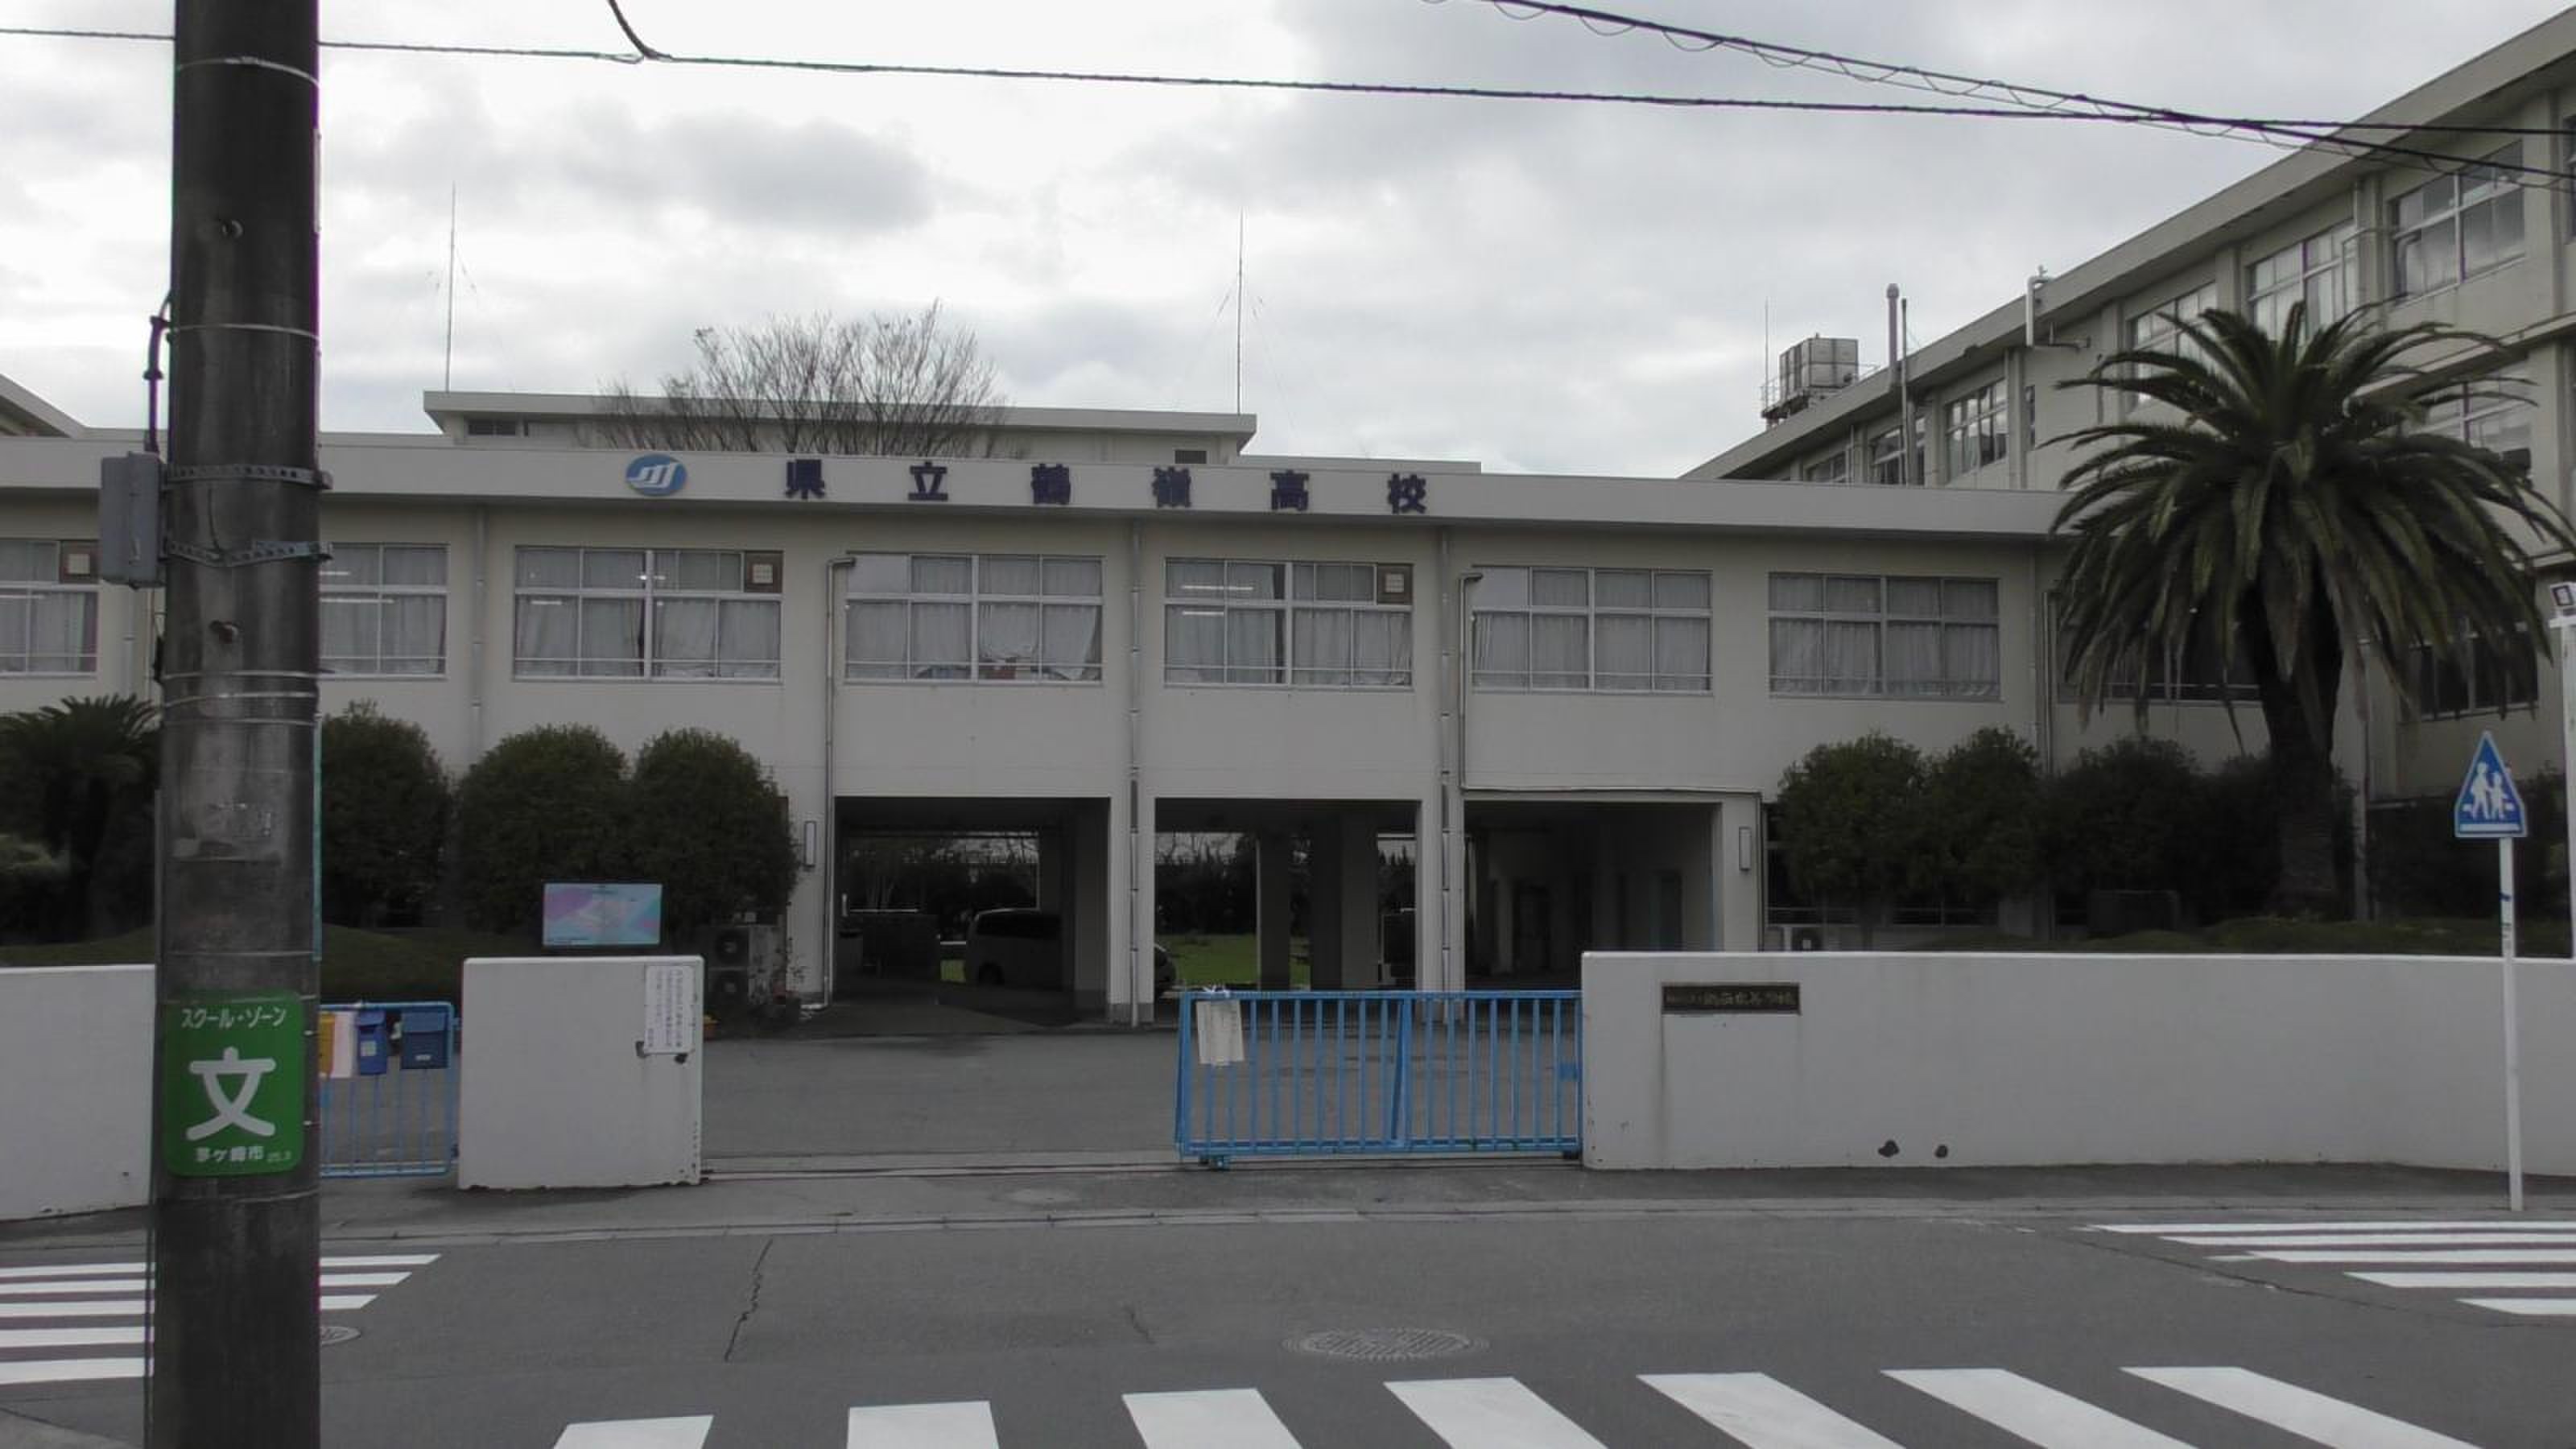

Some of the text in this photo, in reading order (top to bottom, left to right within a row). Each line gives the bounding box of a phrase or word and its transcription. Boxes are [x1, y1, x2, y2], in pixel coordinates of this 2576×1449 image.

[181, 1006, 287, 1029] スクール・ゾーン
[186, 1046, 277, 1141] 文
